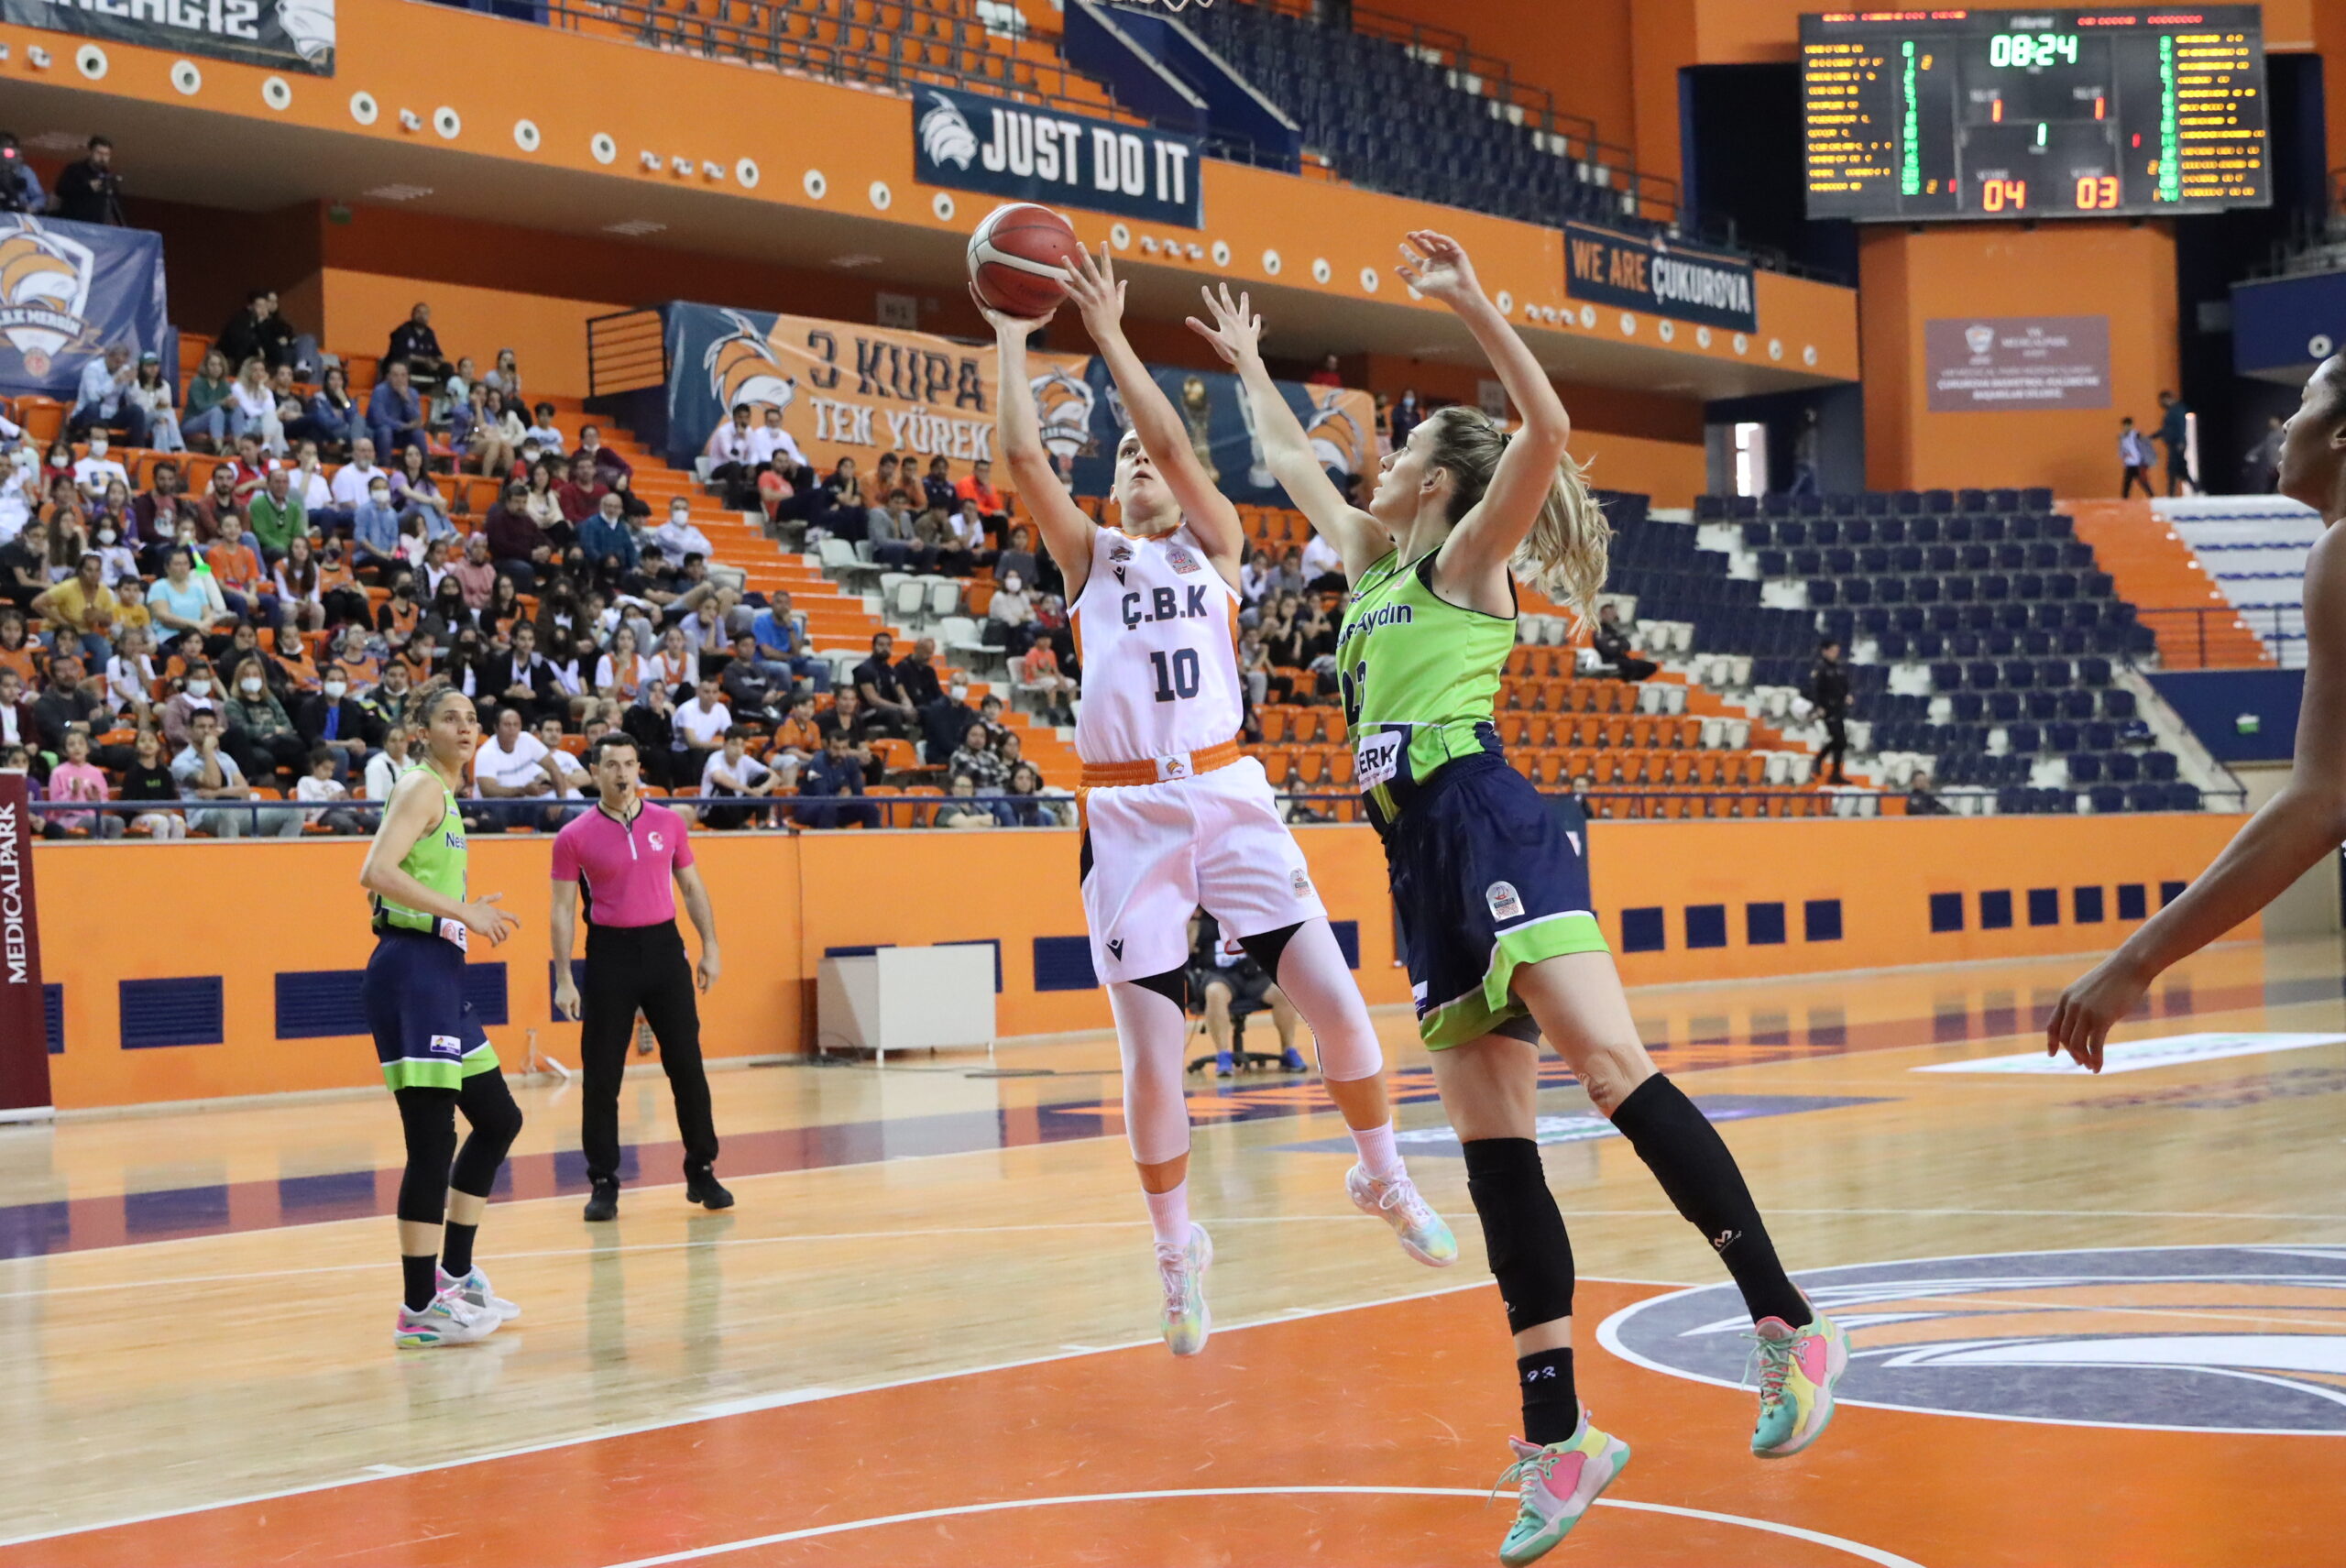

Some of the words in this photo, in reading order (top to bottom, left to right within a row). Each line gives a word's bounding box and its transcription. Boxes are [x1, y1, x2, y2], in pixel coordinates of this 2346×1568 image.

[1990, 34, 2077, 67] 08:24
[981, 107, 1082, 185] JUST
[1091, 126, 1146, 197] DO
[1153, 139, 1189, 204] IT
[1983, 179, 2026, 212] 04
[2077, 176, 2120, 210] 03
[1572, 238, 1606, 283] WE
[1608, 248, 1649, 292] ARE
[1651, 256, 1751, 314] ÇUKUROVA
[808, 329, 840, 389] 3
[856, 335, 987, 412] KUPA
[809, 396, 877, 447] TEK
[884, 405, 994, 463] YÜREK
[1122, 585, 1208, 630] Ç.B.K
[1150, 647, 1200, 703] 10
[0, 802, 27, 984] MEDICALPARK
